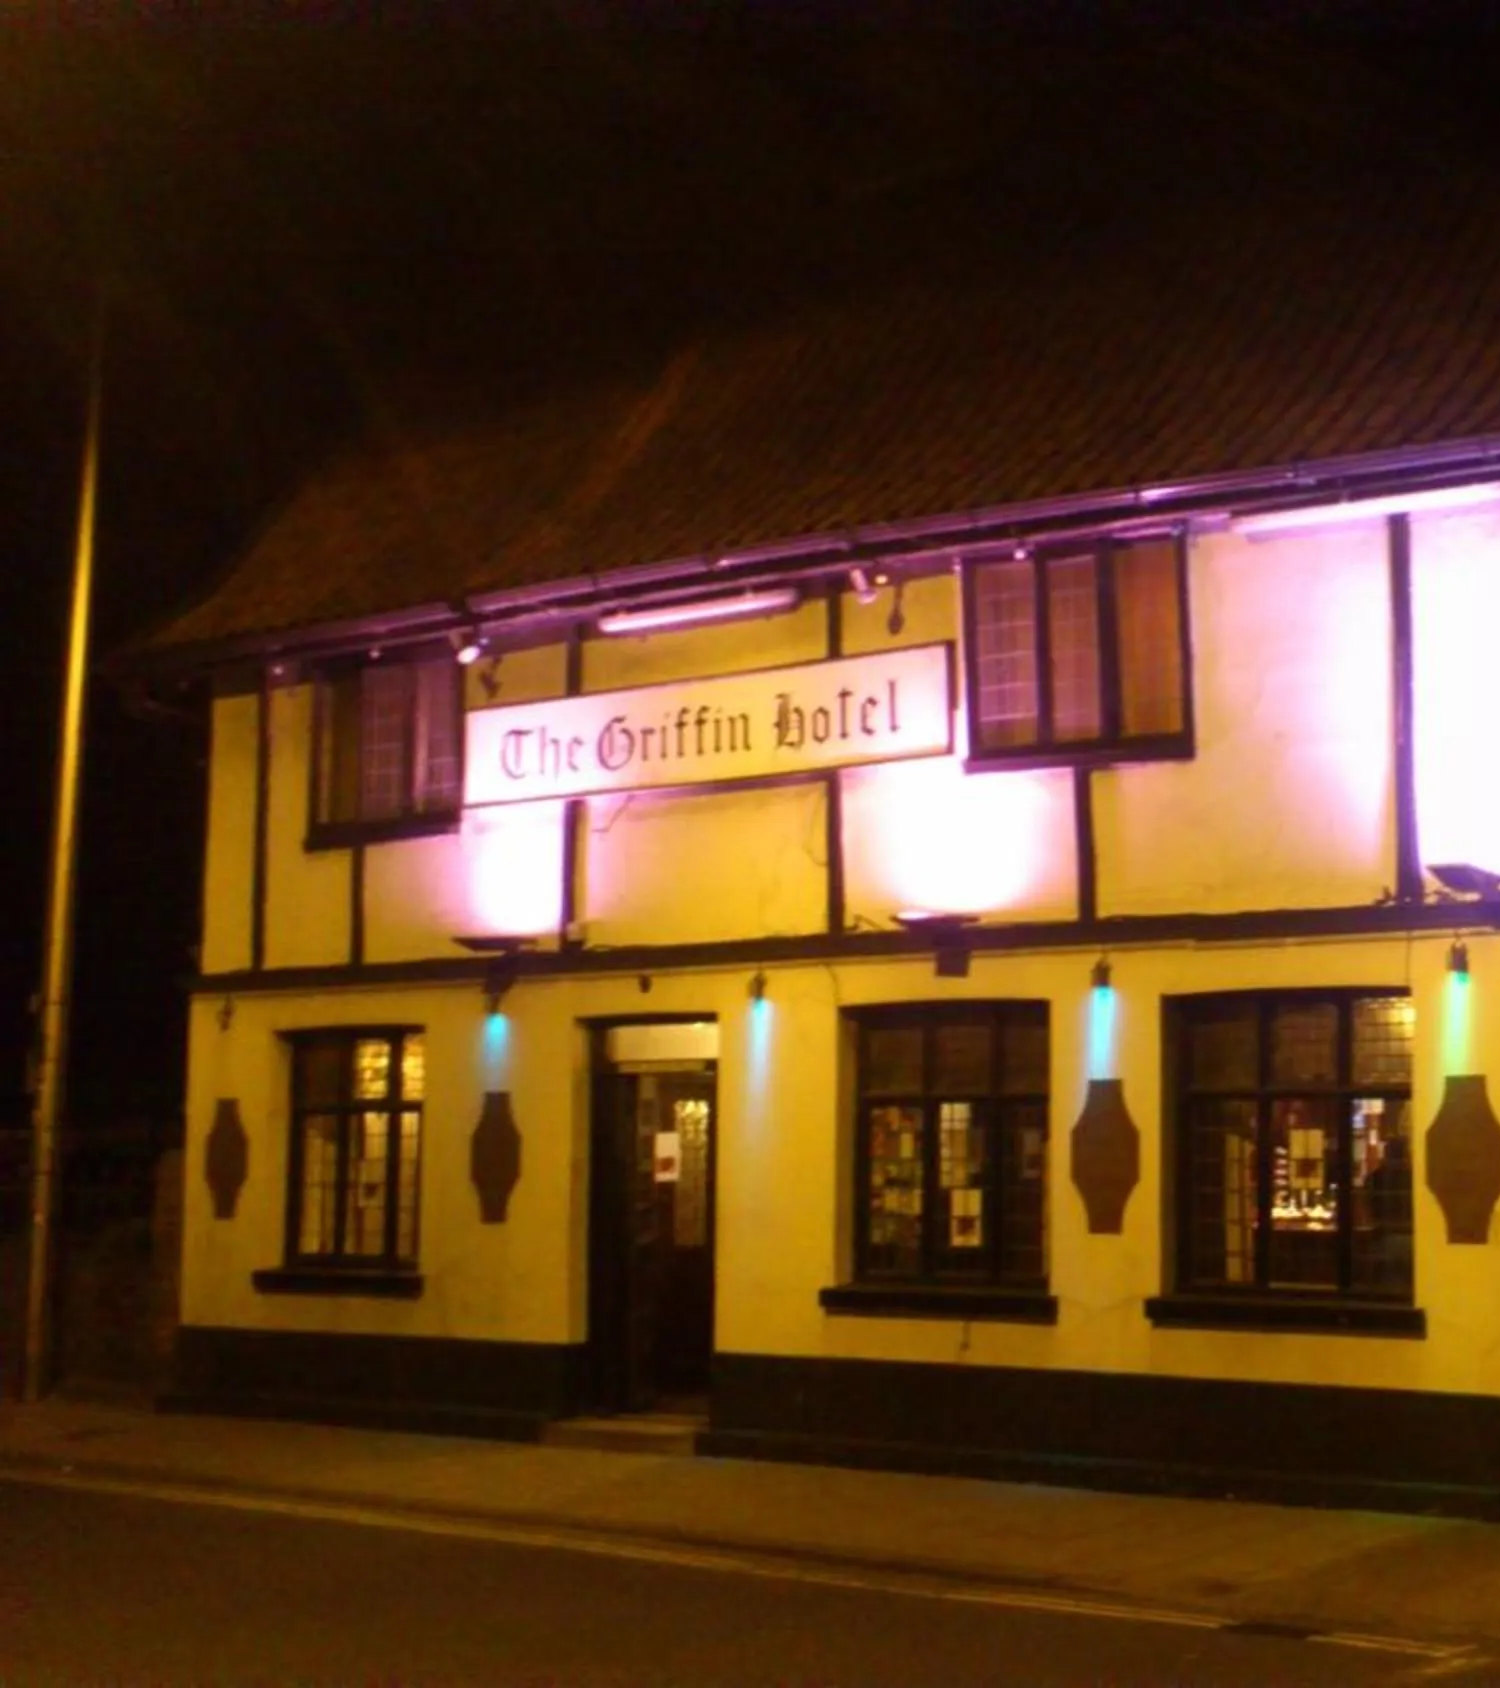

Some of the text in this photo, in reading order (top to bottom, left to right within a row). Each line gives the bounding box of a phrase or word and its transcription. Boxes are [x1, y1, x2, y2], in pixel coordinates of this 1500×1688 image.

[500, 679, 901, 781] The Griffin Hotel
